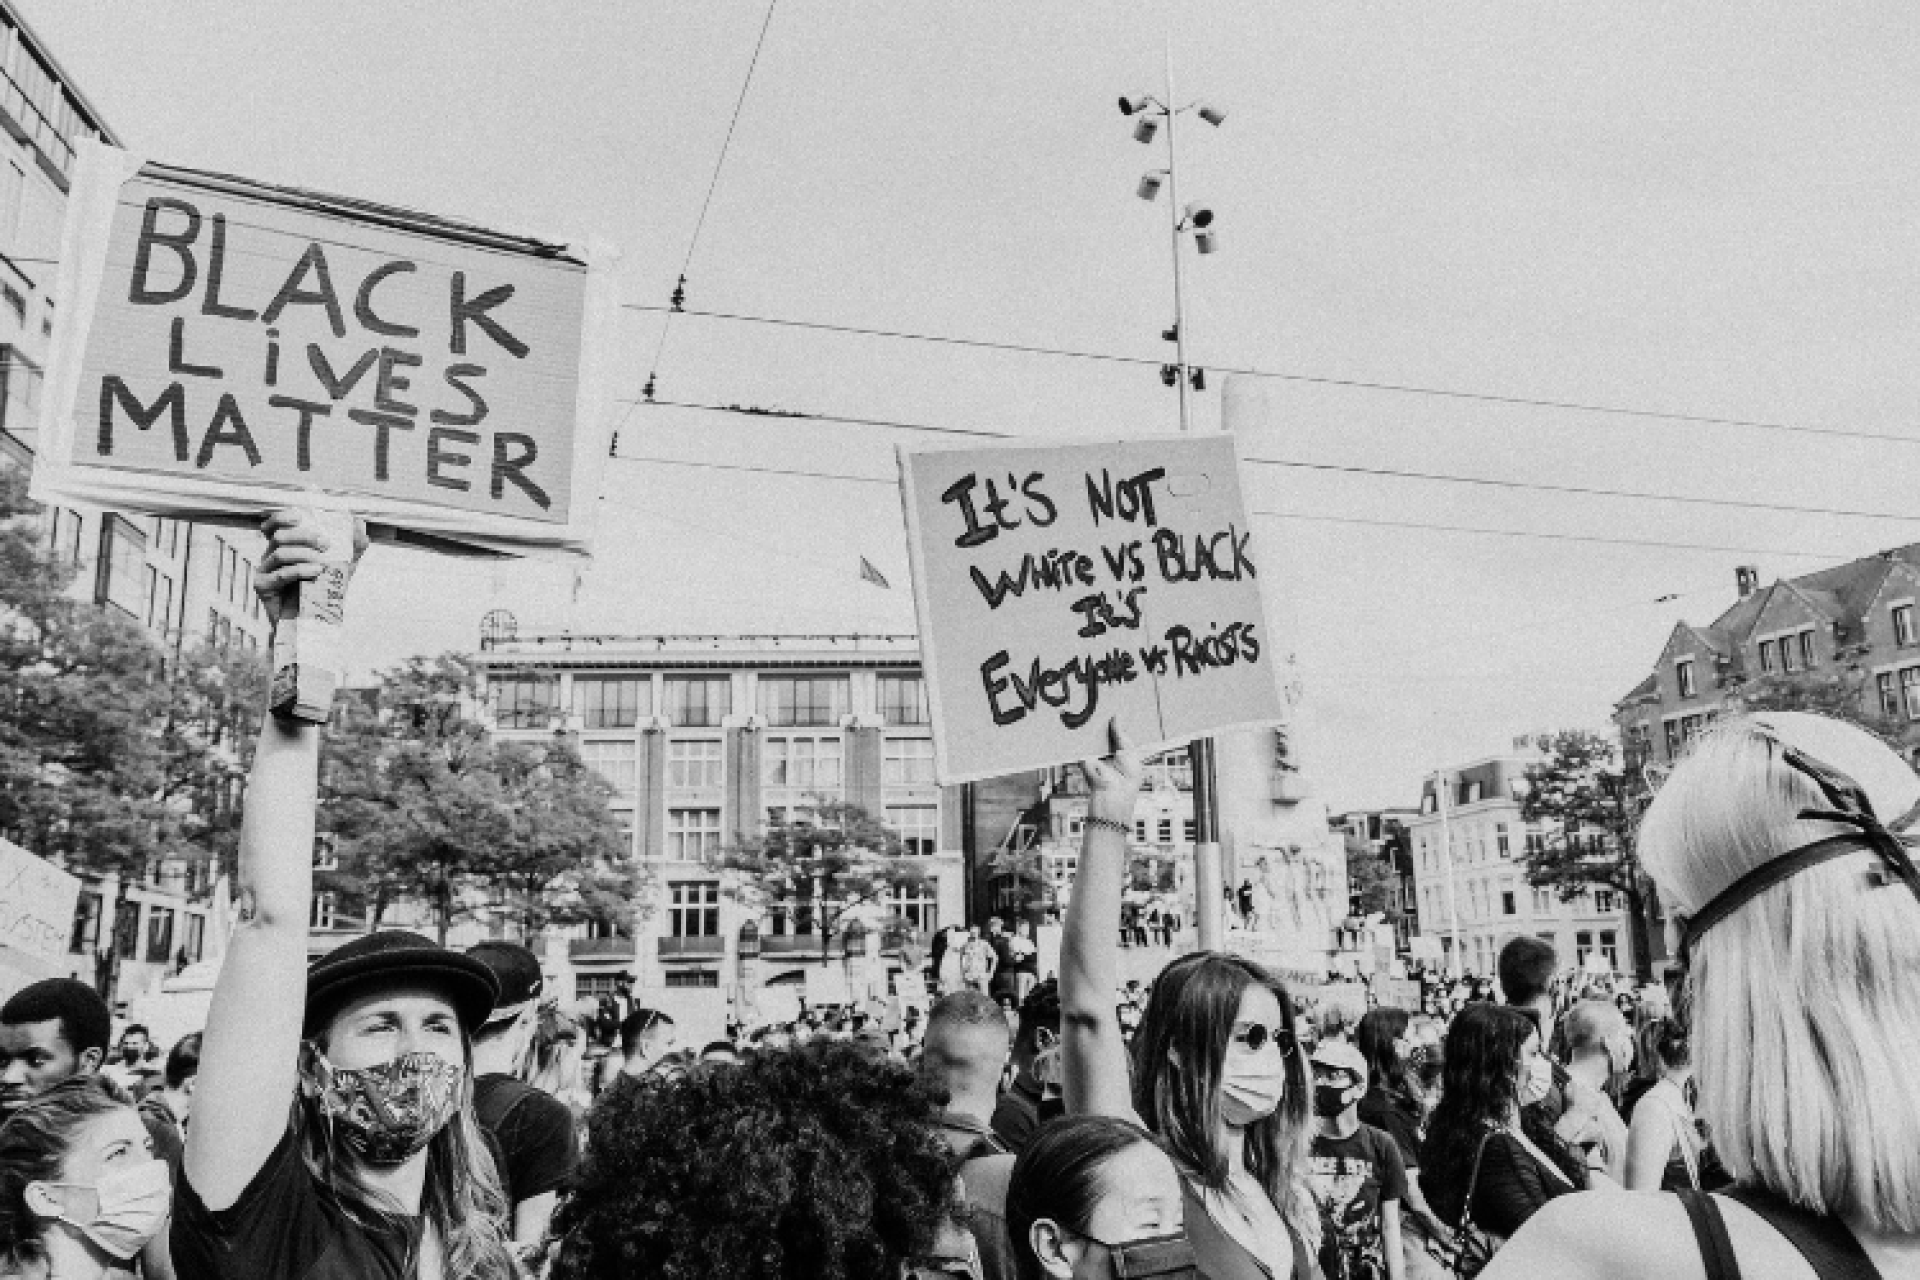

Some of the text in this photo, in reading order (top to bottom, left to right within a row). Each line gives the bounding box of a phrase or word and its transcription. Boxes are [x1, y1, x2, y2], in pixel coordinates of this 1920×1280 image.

[128, 197, 530, 358] BLACK
[97, 376, 551, 510] MATTER
[1085, 467, 1166, 527] NOT
[1152, 522, 1256, 584] BLACK
